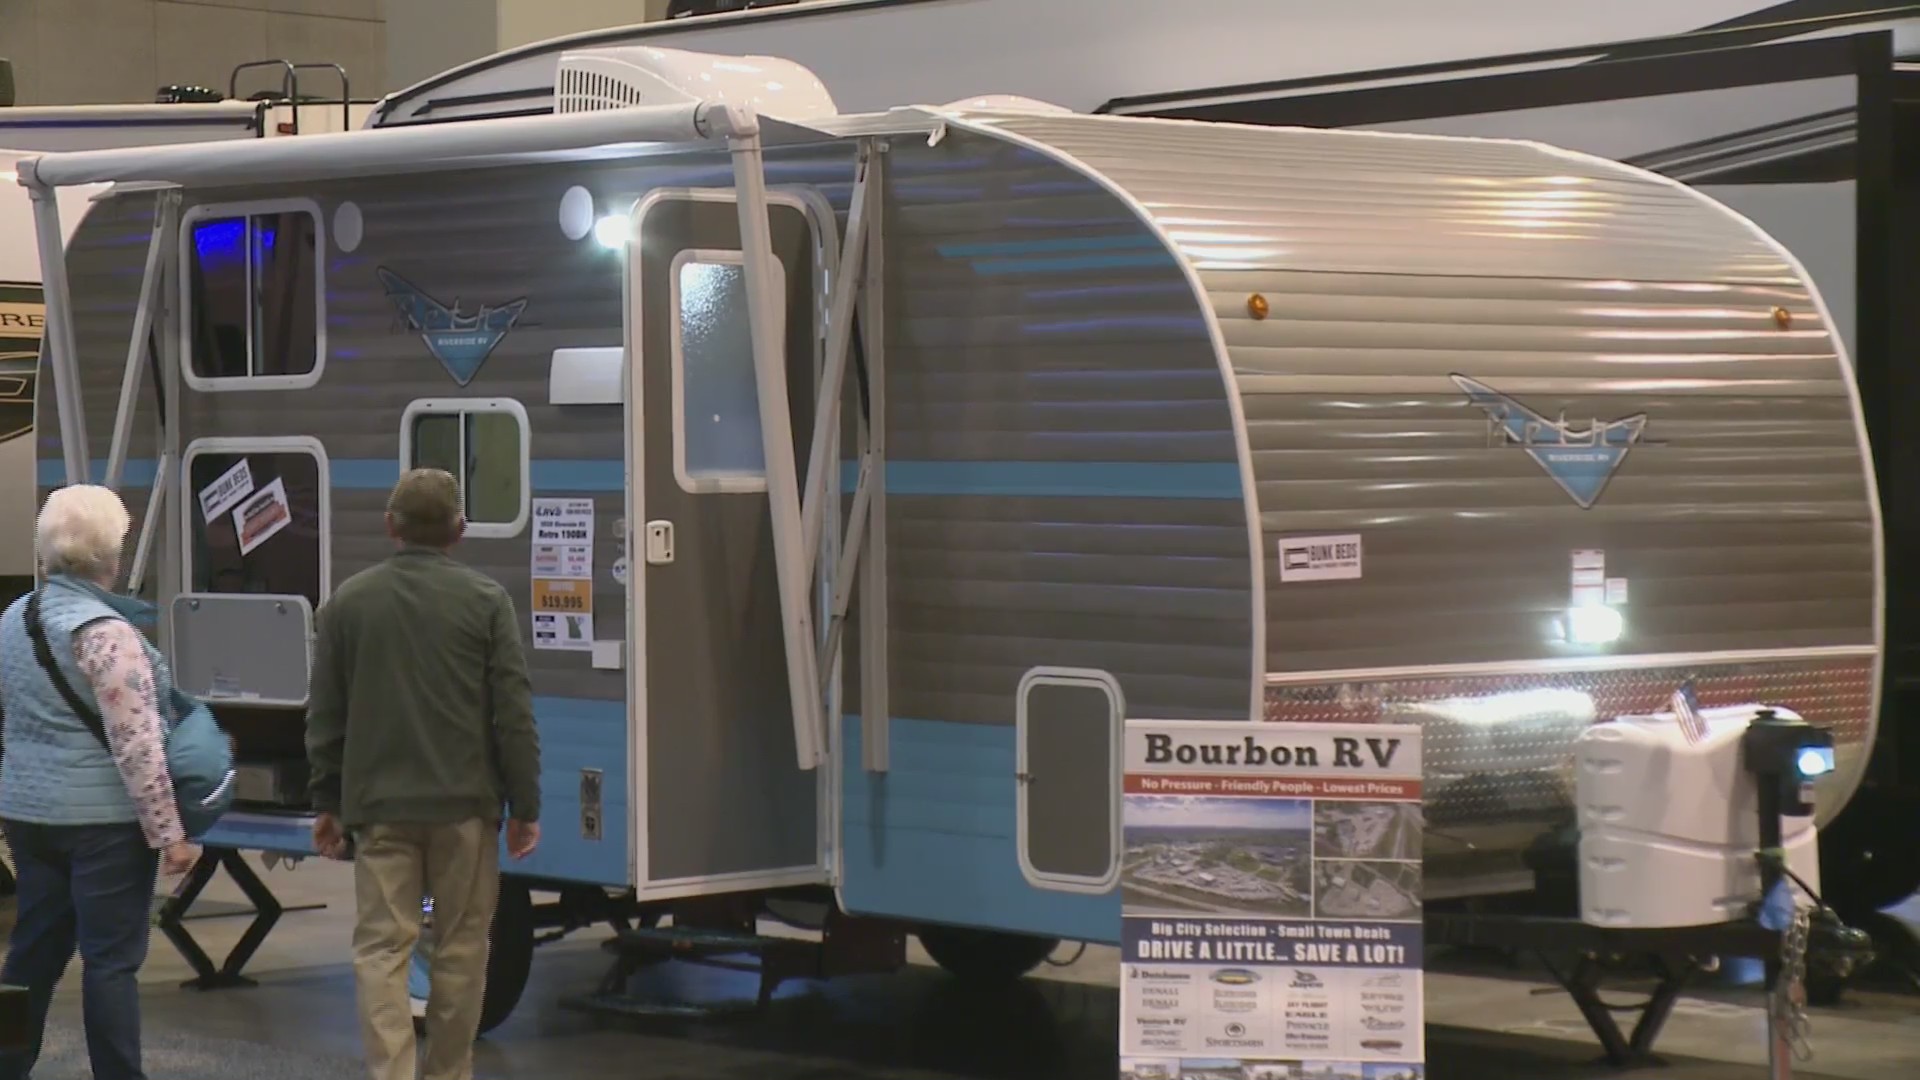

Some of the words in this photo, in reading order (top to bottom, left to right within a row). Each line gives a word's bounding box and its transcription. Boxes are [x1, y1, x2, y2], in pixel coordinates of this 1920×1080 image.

[437, 337, 476, 346] RIVERSIDE
[538, 529, 559, 539] Retro
[1311, 544, 1334, 561] BUNK
[1335, 543, 1358, 560] BEDS
[541, 595, 583, 609] $19,995
[1144, 733, 1319, 767] Bourbon
[1332, 737, 1402, 769] RV
[1141, 778, 1159, 790] No
[1160, 779, 1212, 791] Pressure
[1221, 780, 1270, 794] Friendly
[1272, 781, 1314, 794] People
[1322, 782, 1366, 794] Lowest
[1367, 782, 1404, 795] Prices
[1151, 922, 1173, 938] Big
[1175, 923, 1202, 939] City
[1204, 923, 1267, 938] Selection
[1278, 924, 1315, 939] Small
[1318, 925, 1352, 939] Town
[1354, 926, 1391, 940] Deals
[1138, 940, 1194, 960] DRIVE
[1199, 941, 1212, 960] A
[1216, 941, 1289, 961] LITTLE...
[1294, 943, 1341, 963] SAVE
[1346, 944, 1359, 963] A
[1363, 944, 1405, 964] LOT!
